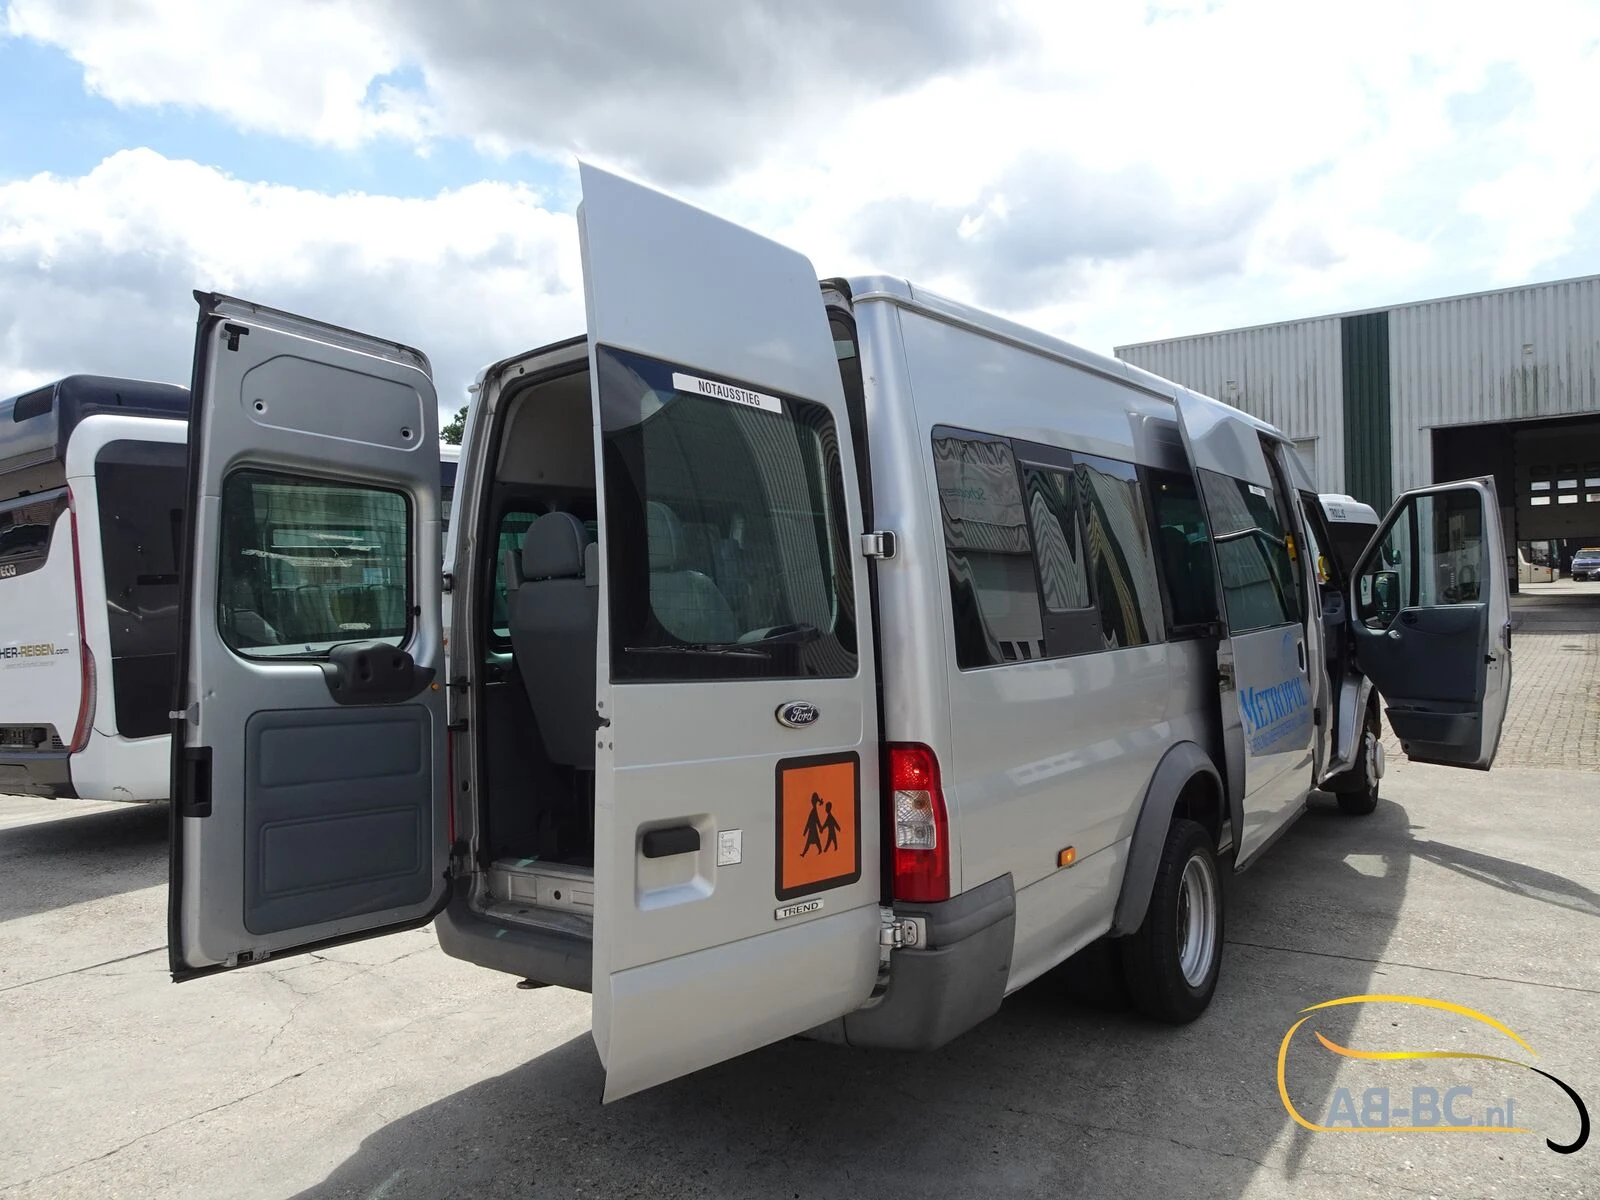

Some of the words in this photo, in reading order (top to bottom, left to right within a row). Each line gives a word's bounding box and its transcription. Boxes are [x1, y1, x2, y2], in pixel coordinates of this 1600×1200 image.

[698, 380, 760, 406] NOTAUSSTIEG
[790, 704, 814, 722] Ford
[1240, 677, 1307, 735] METROPOL
[783, 902, 819, 917] TREND
